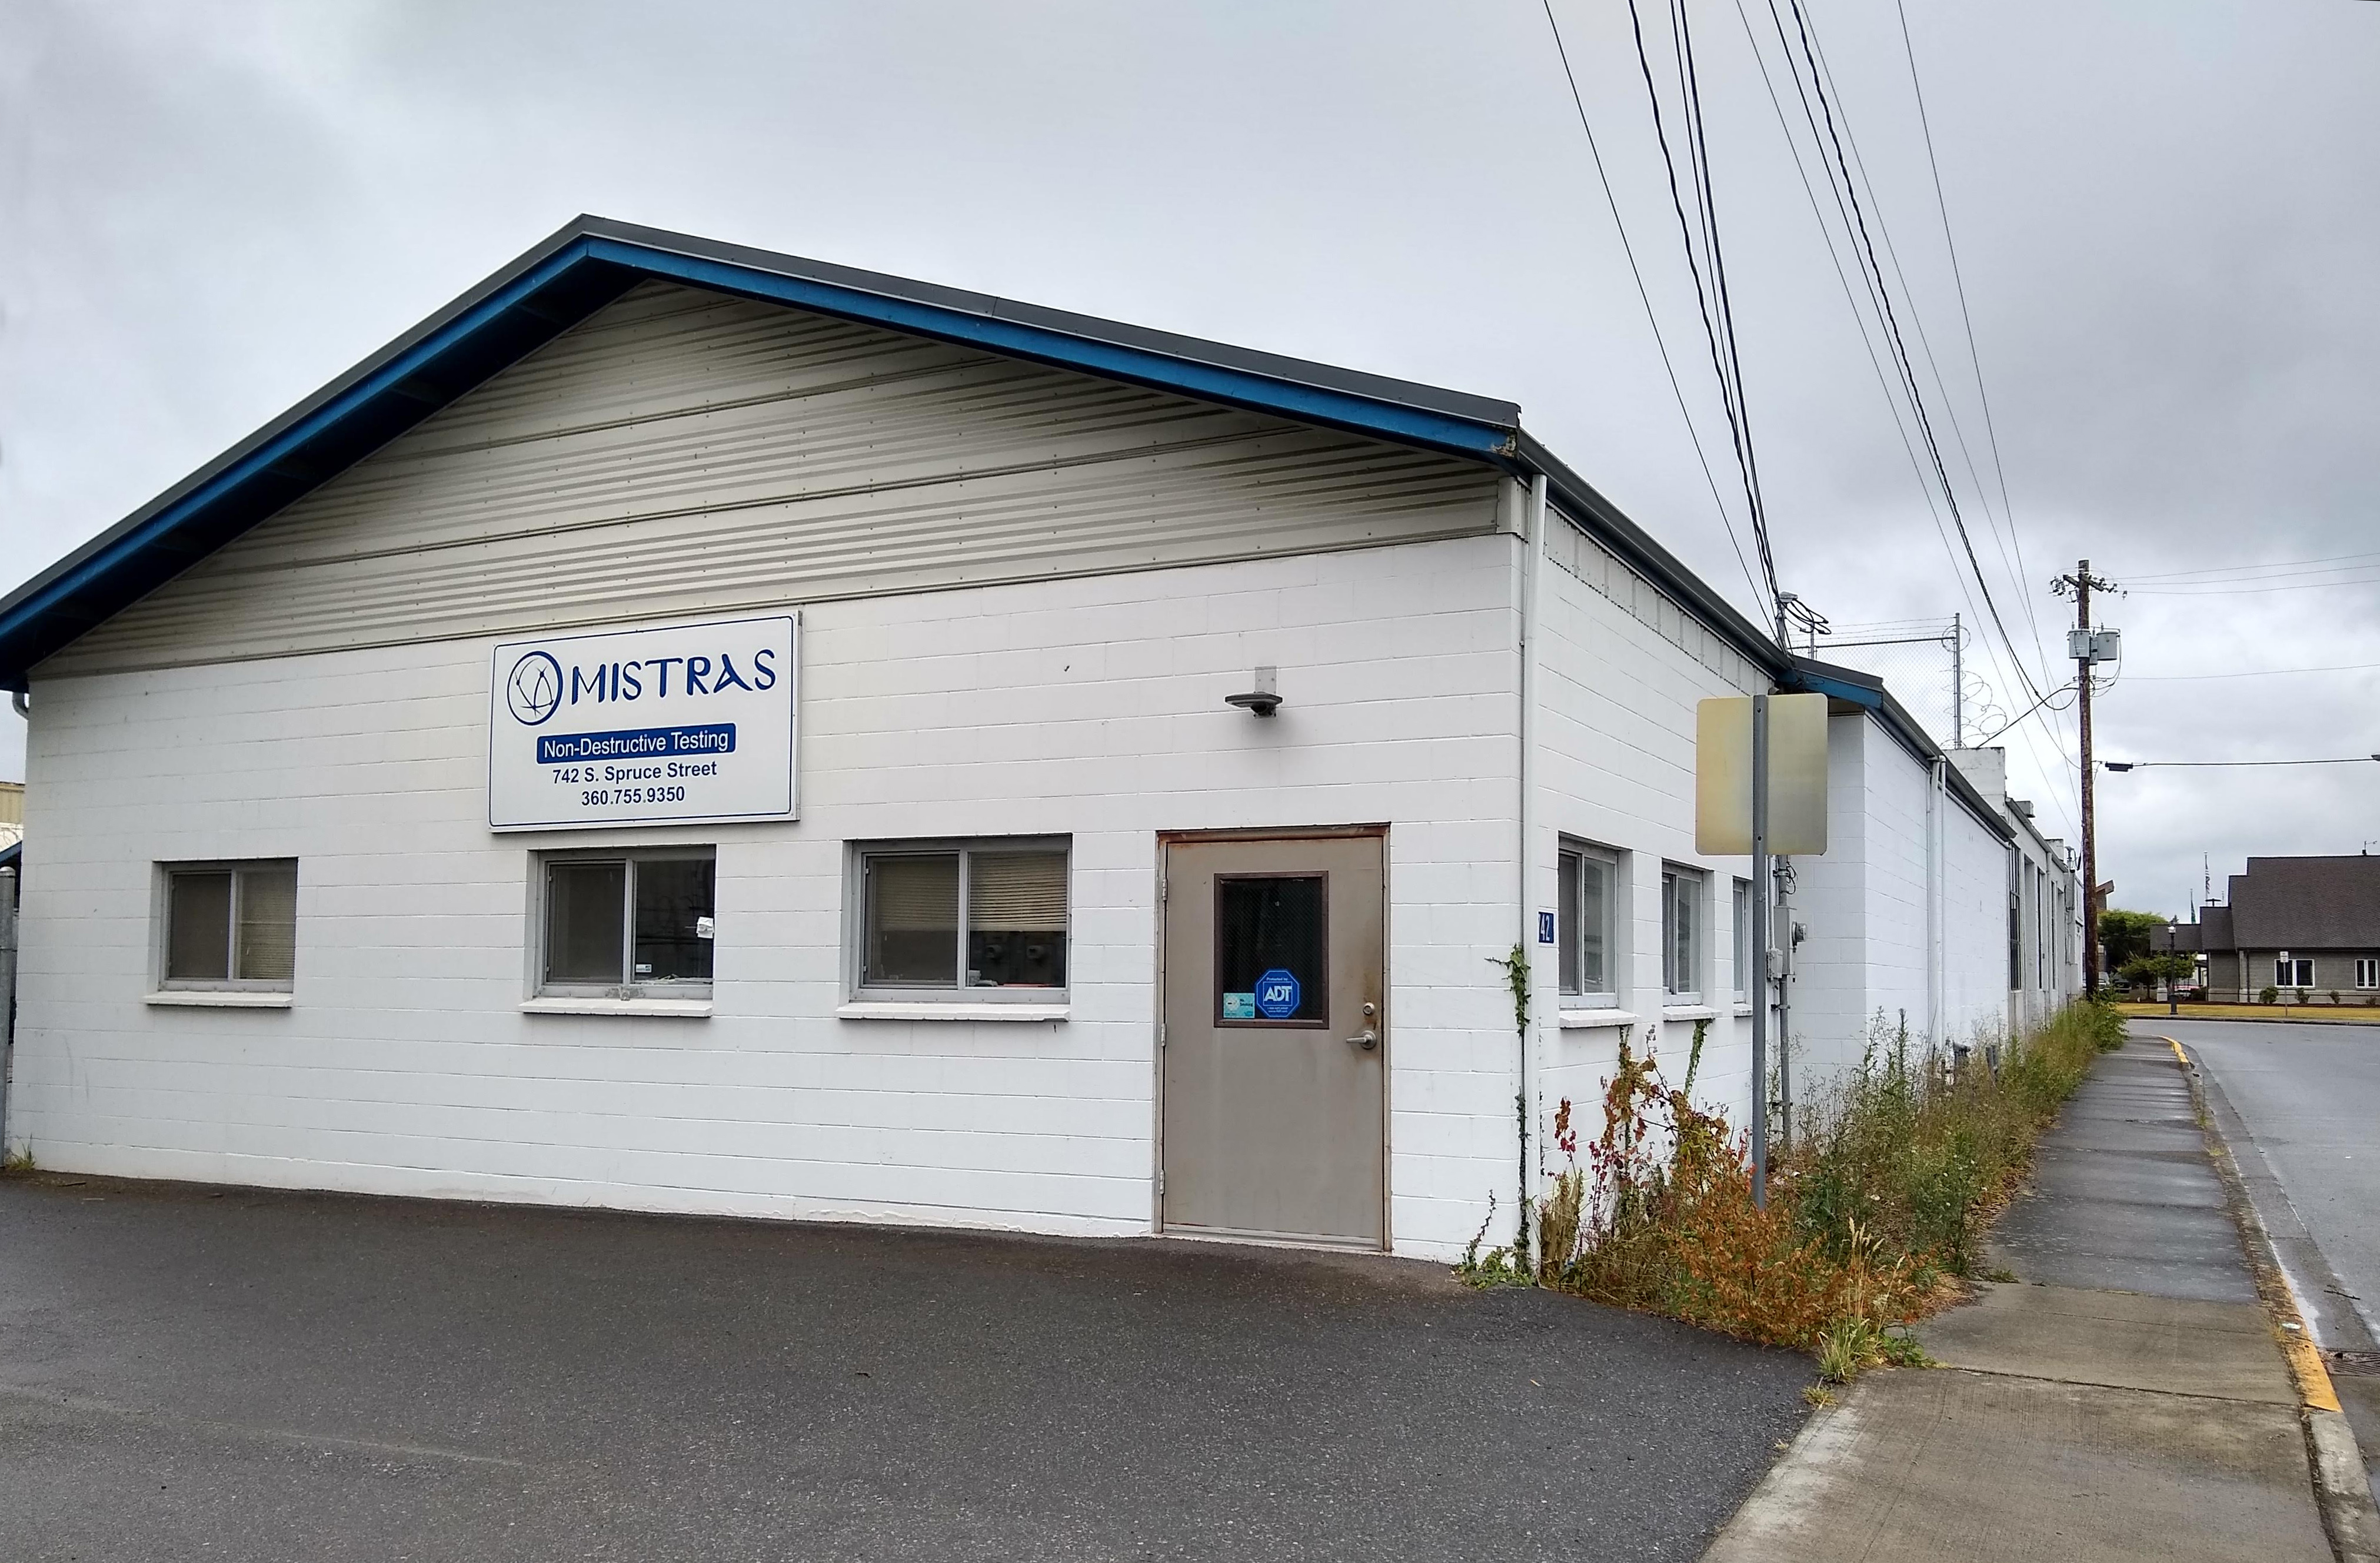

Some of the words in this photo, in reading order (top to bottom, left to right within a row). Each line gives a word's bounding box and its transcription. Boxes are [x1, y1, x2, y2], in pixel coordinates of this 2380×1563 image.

[571, 649, 776, 706] MISTRAS
[544, 734, 666, 759] Non-Destructive
[670, 730, 728, 751] Testing
[552, 768, 579, 784] 742
[584, 767, 599, 783] S.
[604, 766, 662, 784] Spruce
[667, 761, 717, 778] Street
[581, 786, 685, 806] 360.755.9350
[1264, 985, 1292, 1002] ADT
